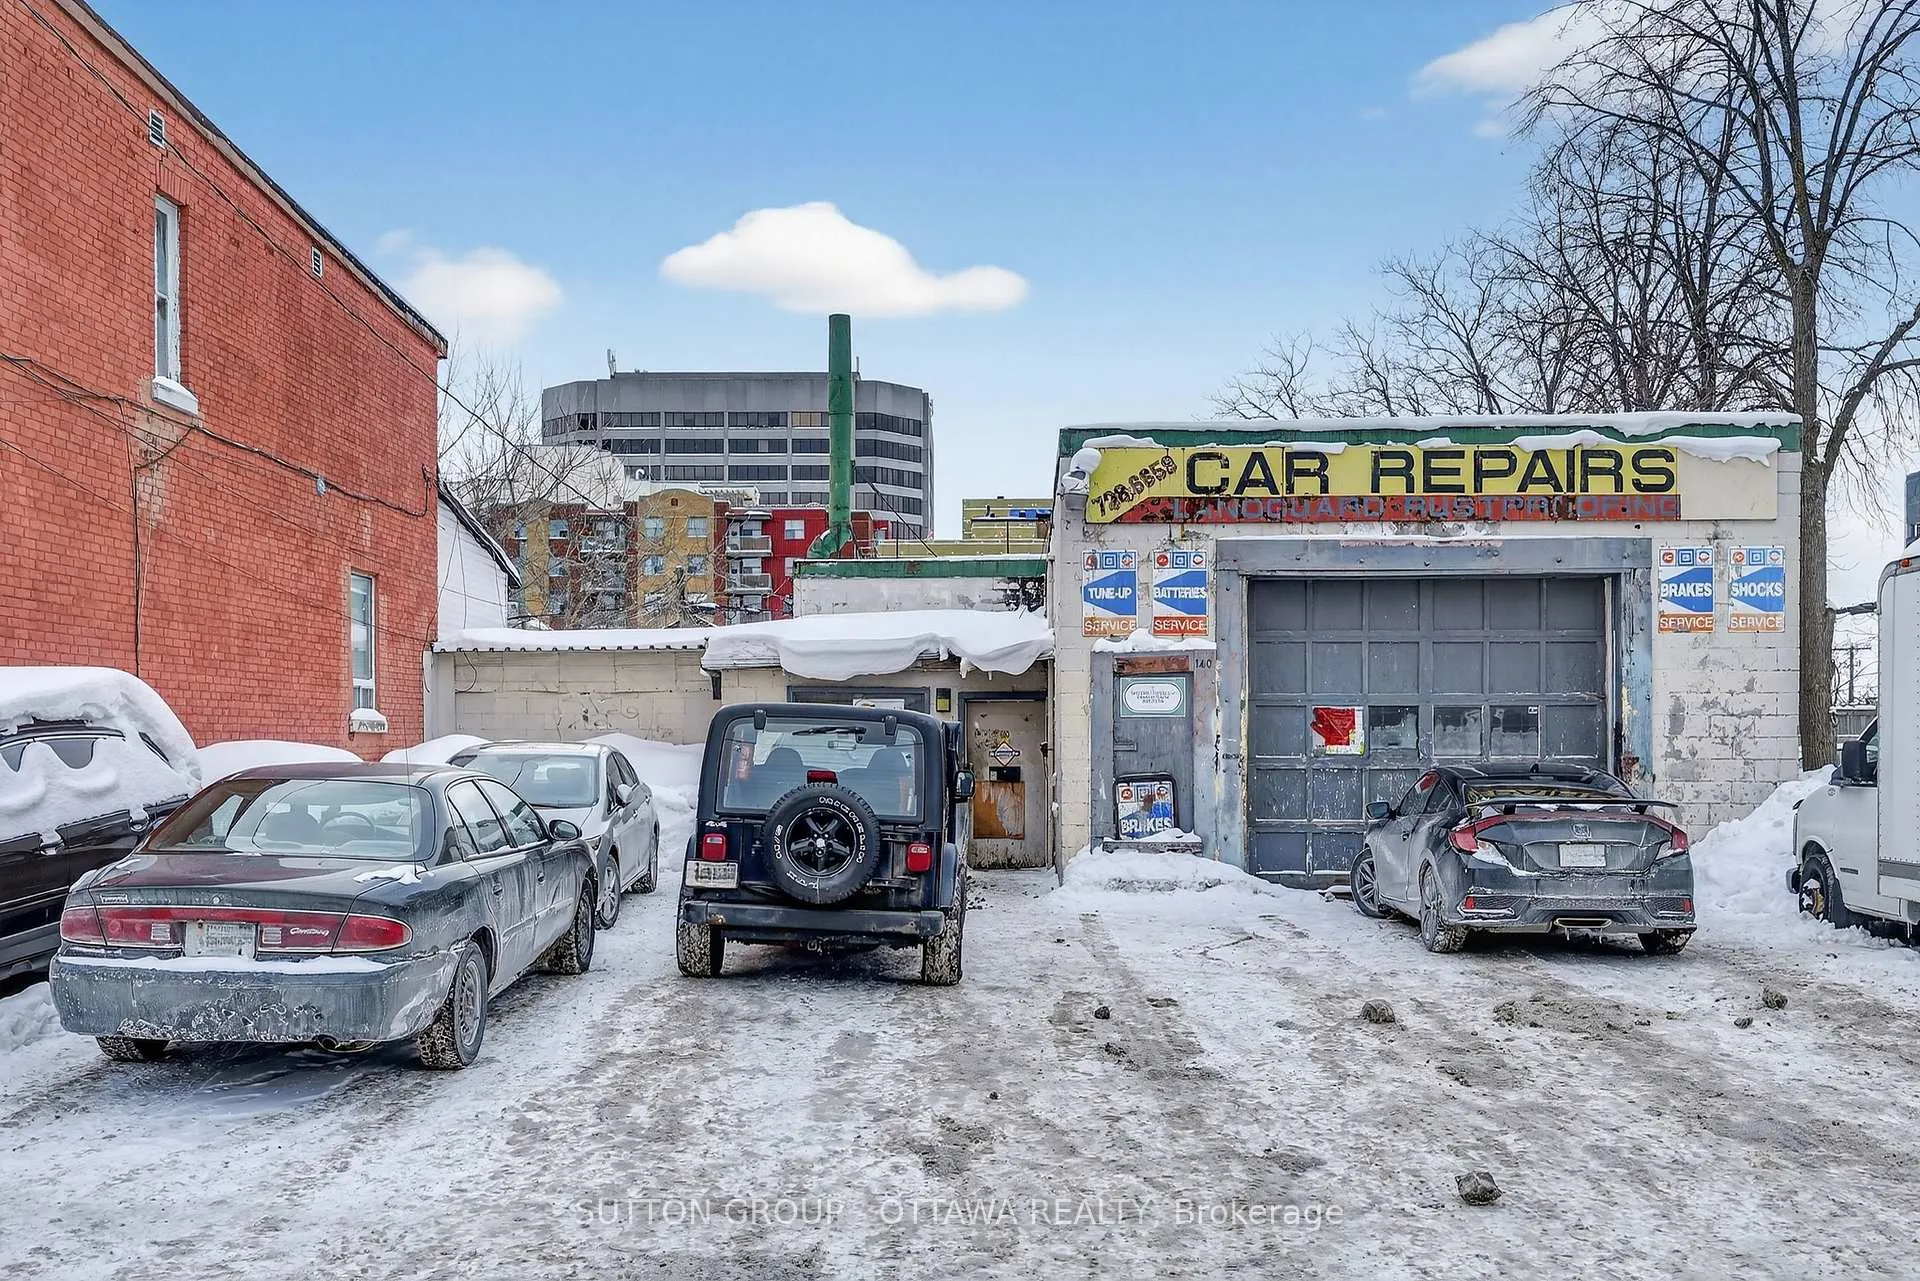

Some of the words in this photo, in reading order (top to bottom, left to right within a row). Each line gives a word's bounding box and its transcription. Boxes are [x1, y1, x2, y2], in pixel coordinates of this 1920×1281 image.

[1186, 451, 1329, 495] CAR
[1371, 449, 1676, 493] REPAIRS
[1088, 587, 1133, 600] TUNE-UP
[1153, 586, 1207, 599] BATTERIES
[1661, 582, 1713, 597] BRAKES
[1731, 582, 1784, 597] SHOCKS
[1084, 619, 1136, 632] SERVICE
[1153, 619, 1207, 631] SERVICE
[1660, 616, 1713, 629] SERVICE
[1730, 616, 1784, 629] SERVICE
